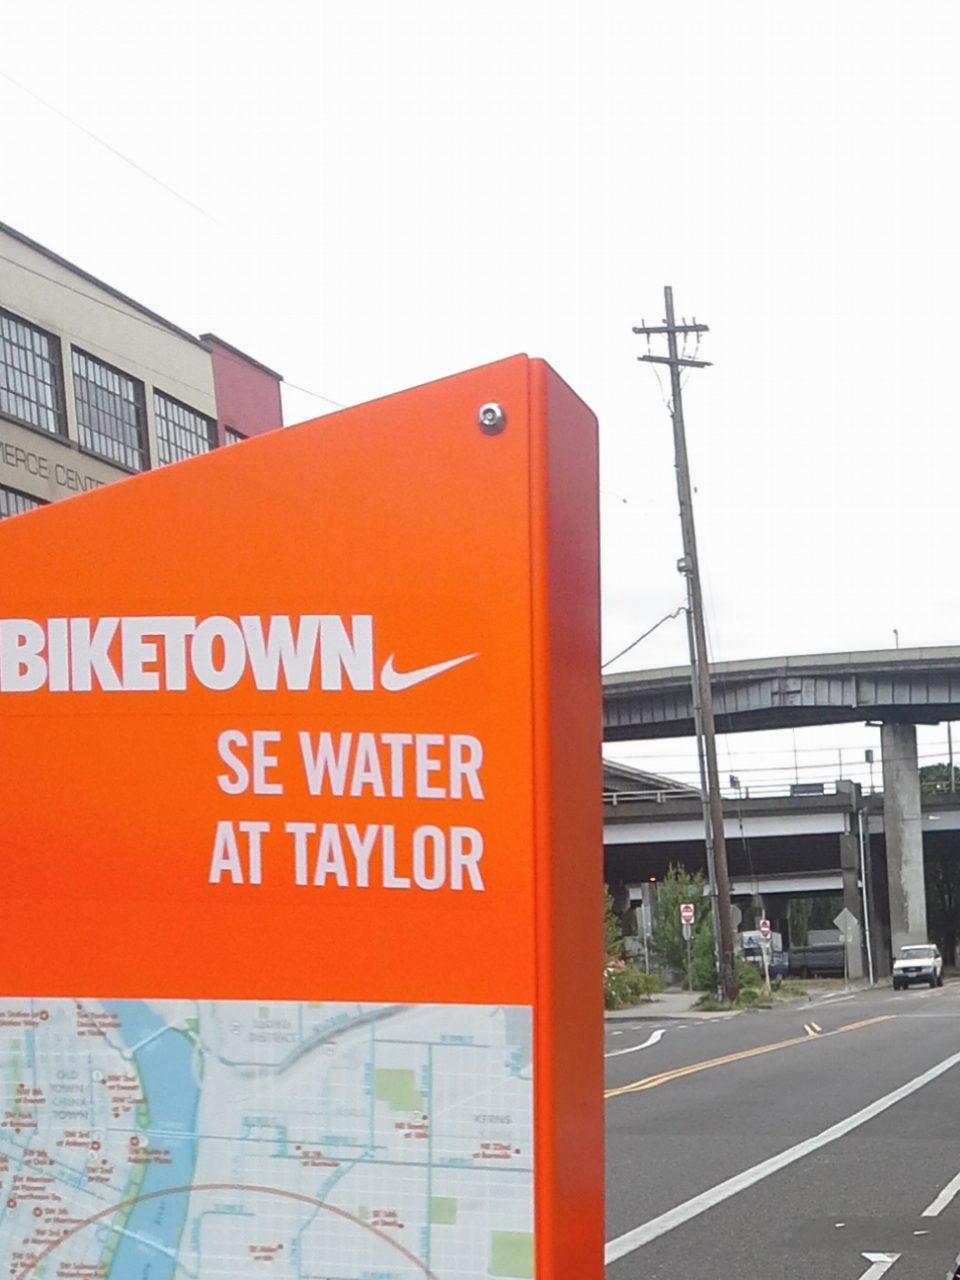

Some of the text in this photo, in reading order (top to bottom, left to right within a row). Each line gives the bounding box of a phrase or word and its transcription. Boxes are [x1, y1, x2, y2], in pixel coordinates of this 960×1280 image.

[55, 463, 107, 492] CENT
[0, 614, 374, 692] BIKETOWN
[216, 729, 485, 801] SE WATER
[208, 820, 485, 891] AT TAYLOR
